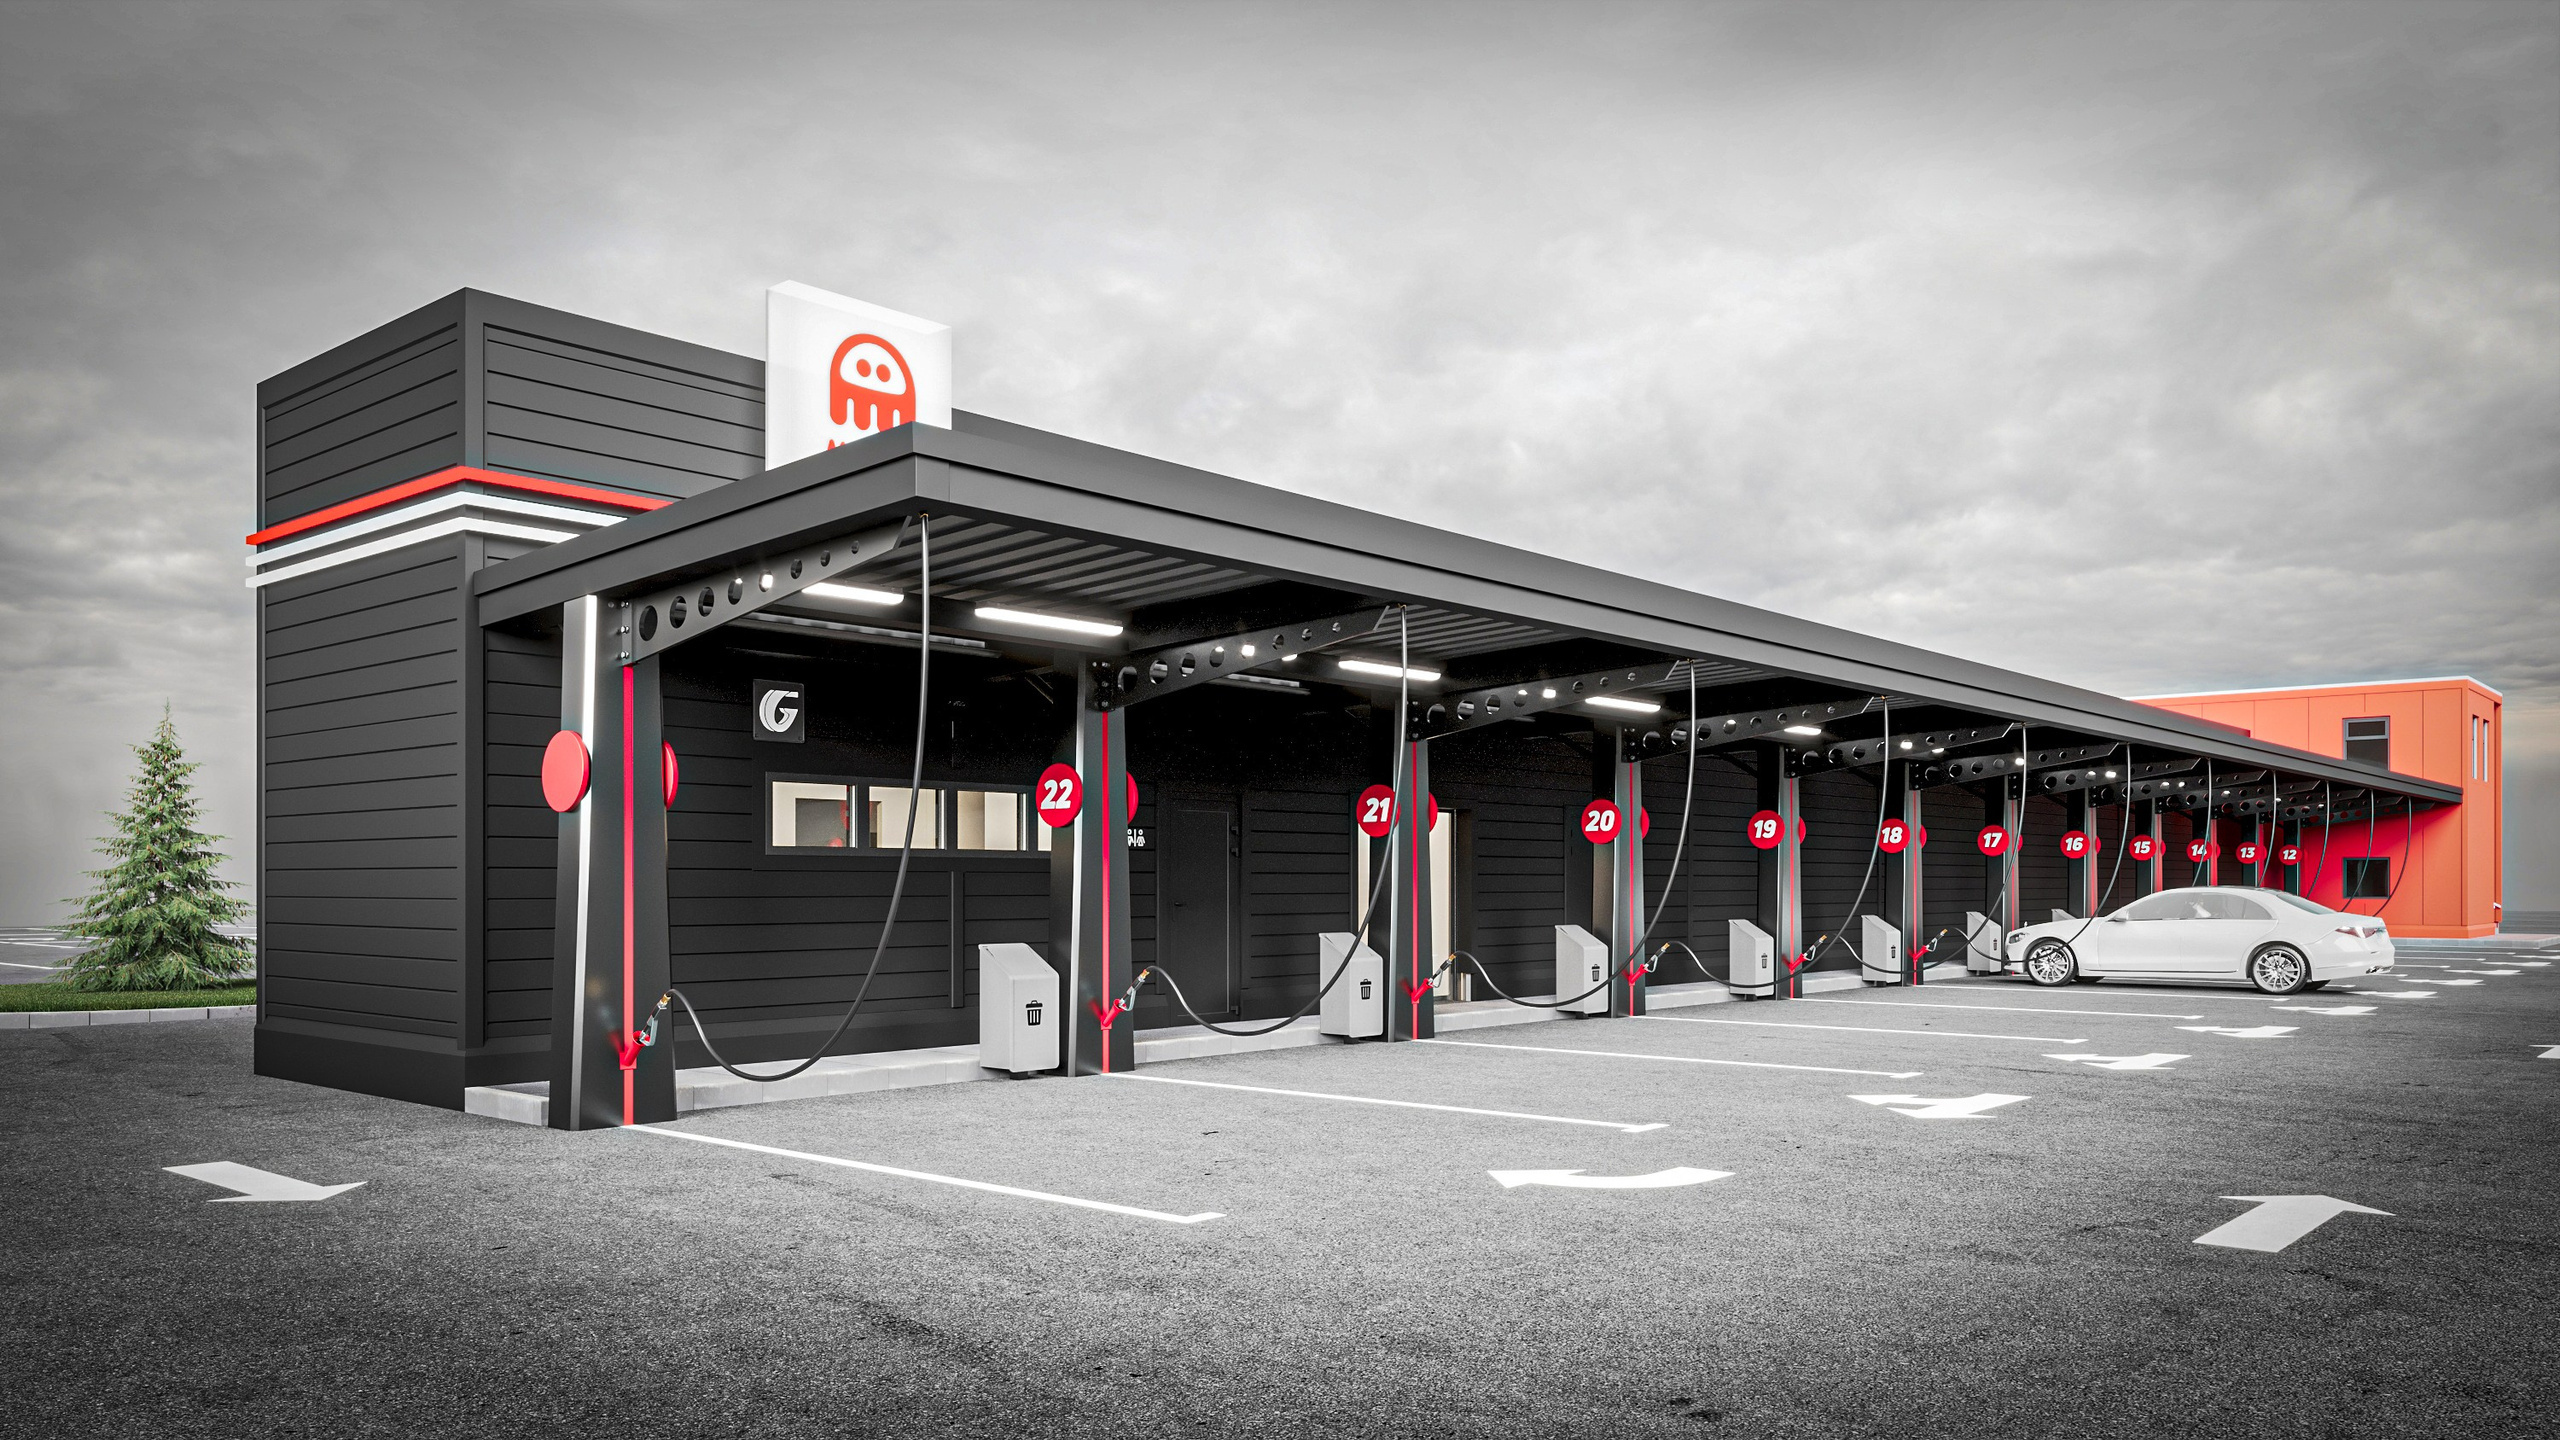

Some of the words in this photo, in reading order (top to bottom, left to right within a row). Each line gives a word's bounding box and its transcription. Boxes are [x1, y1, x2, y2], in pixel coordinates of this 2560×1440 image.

[1040, 778, 1073, 810] 22
[1362, 797, 1391, 823] 21
[1585, 810, 1615, 832] 20
[1754, 819, 1777, 838] 19
[1882, 827, 1903, 844] 18
[1983, 832, 2002, 848] 17
[2065, 837, 2084, 851] 16
[2134, 841, 2151, 854] 15
[2191, 844, 2207, 857] 14
[2240, 847, 2256, 859] 13
[2282, 849, 2297, 860] 12
